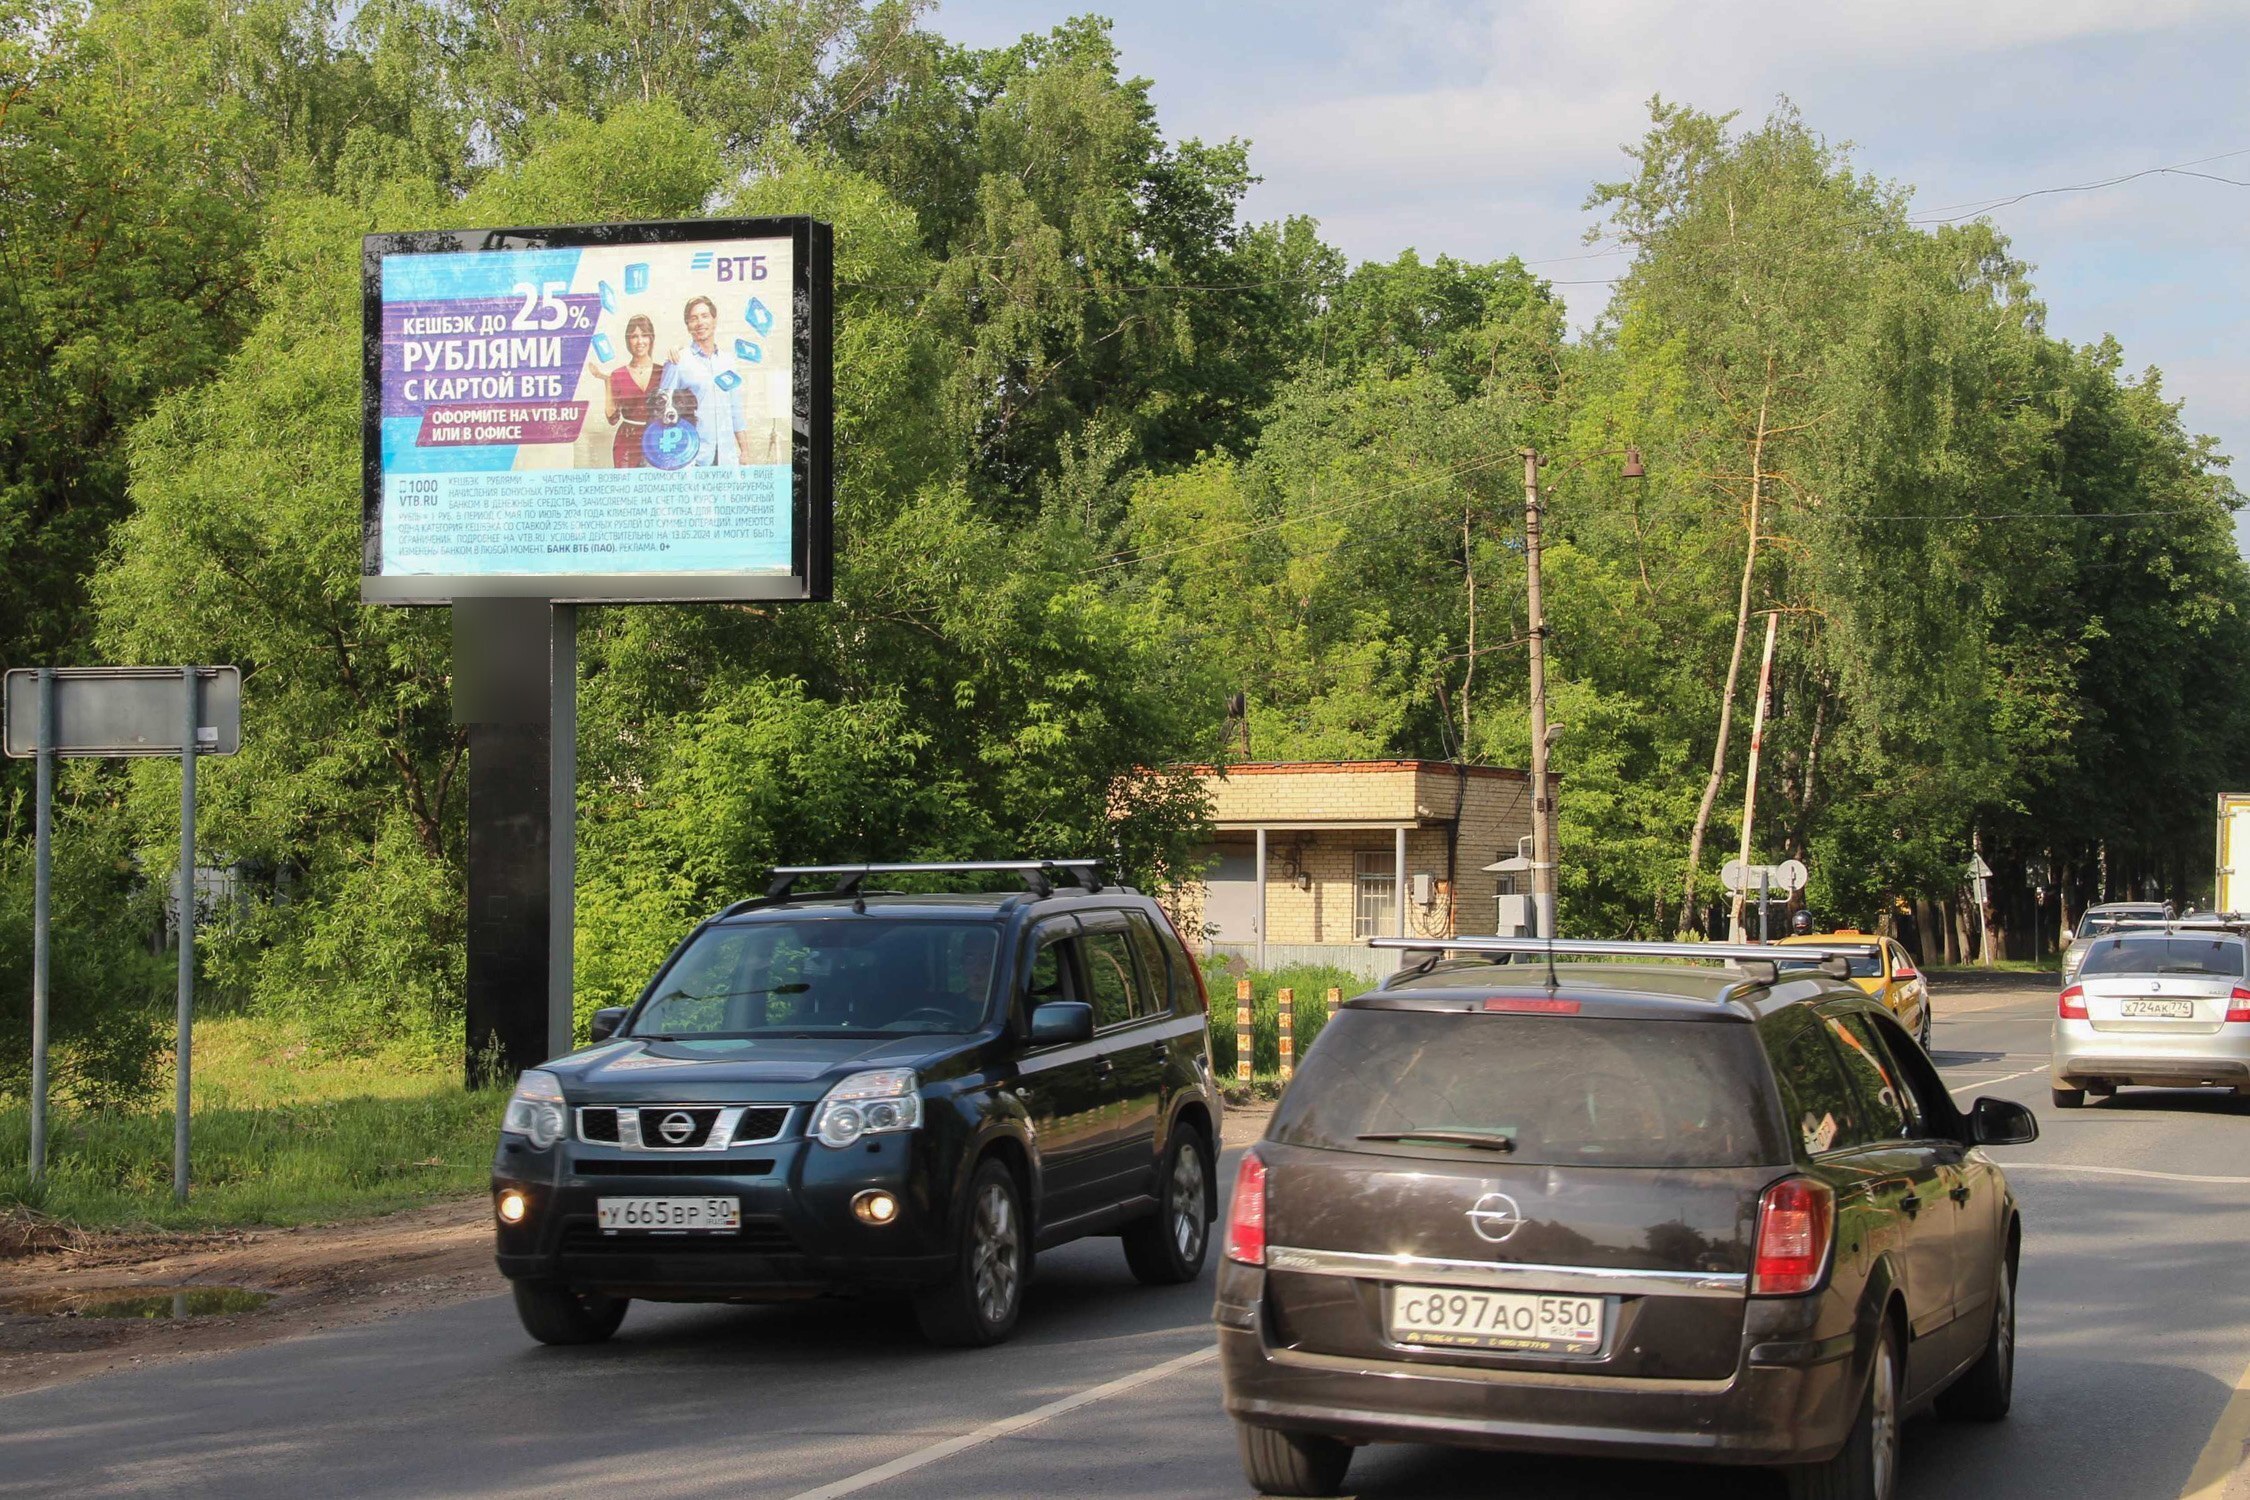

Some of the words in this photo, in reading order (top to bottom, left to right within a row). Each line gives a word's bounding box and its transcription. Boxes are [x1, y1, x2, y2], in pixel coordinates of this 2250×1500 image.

[717, 255, 768, 282] ВТБ
[403, 316, 476, 335] КЕШБЭК
[479, 315, 506, 336] ДО
[403, 337, 561, 372] РУБЛЯМИ
[403, 379, 418, 401] С
[424, 371, 514, 400] КАРТОЙ
[521, 375, 563, 398] ВТБ
[432, 410, 507, 425] ОФОРМИТЕ
[509, 408, 529, 422] НА
[531, 407, 579, 422] VTB.RU
[432, 426, 460, 441] ИЛИ
[463, 426, 472, 440] В
[475, 425, 522, 440] ОФИСЕ
[409, 479, 438, 493] 1000
[501, 486, 542, 496] БОНУСНЫХ
[399, 495, 438, 507] VTB.RU
[504, 510, 521, 519] МАЯ
[524, 509, 536, 519] ПО
[539, 510, 561, 519] ИЮЛЬ
[584, 509, 604, 519] ГОДА
[607, 508, 648, 518] КЛИЕНТАМ
[515, 520, 552, 531] СТАВКОЙ
[645, 518, 654, 528] ОТ
[503, 533, 515, 542] НА
[657, 530, 668, 540] НА
[723, 529, 750, 539] МОГУТ
[753, 528, 774, 538] БЫТЬ
[547, 544, 571, 554] БАНК
[572, 543, 589, 553] ВТБ
[659, 542, 670, 551] 0+
[1540, 1299, 1592, 1327] 550
[1550, 1326, 1576, 1337] RUS
